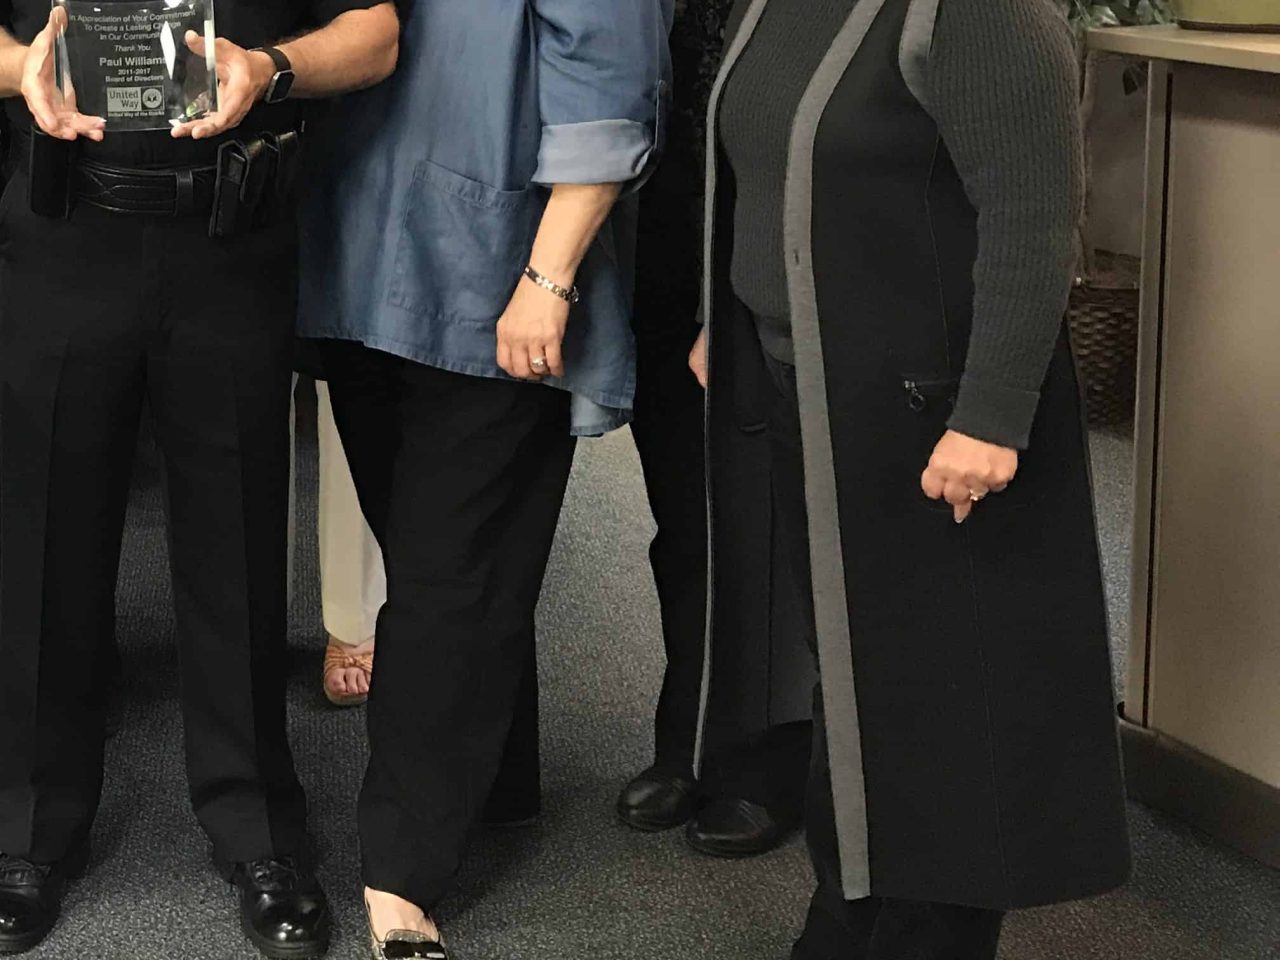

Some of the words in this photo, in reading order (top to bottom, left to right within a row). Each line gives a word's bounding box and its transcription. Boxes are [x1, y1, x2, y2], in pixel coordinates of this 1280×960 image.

[77, 14, 121, 24] Appreciation
[132, 14, 148, 22] Your
[150, 9, 196, 21] Commitment
[126, 23, 152, 33] Lasting
[153, 21, 181, 30] Chnge
[114, 44, 135, 52] Thank
[99, 57, 122, 66] Paul
[105, 75, 125, 83] Board
[134, 74, 164, 82] Directors
[109, 89, 139, 100] United
[121, 99, 139, 110] Way
